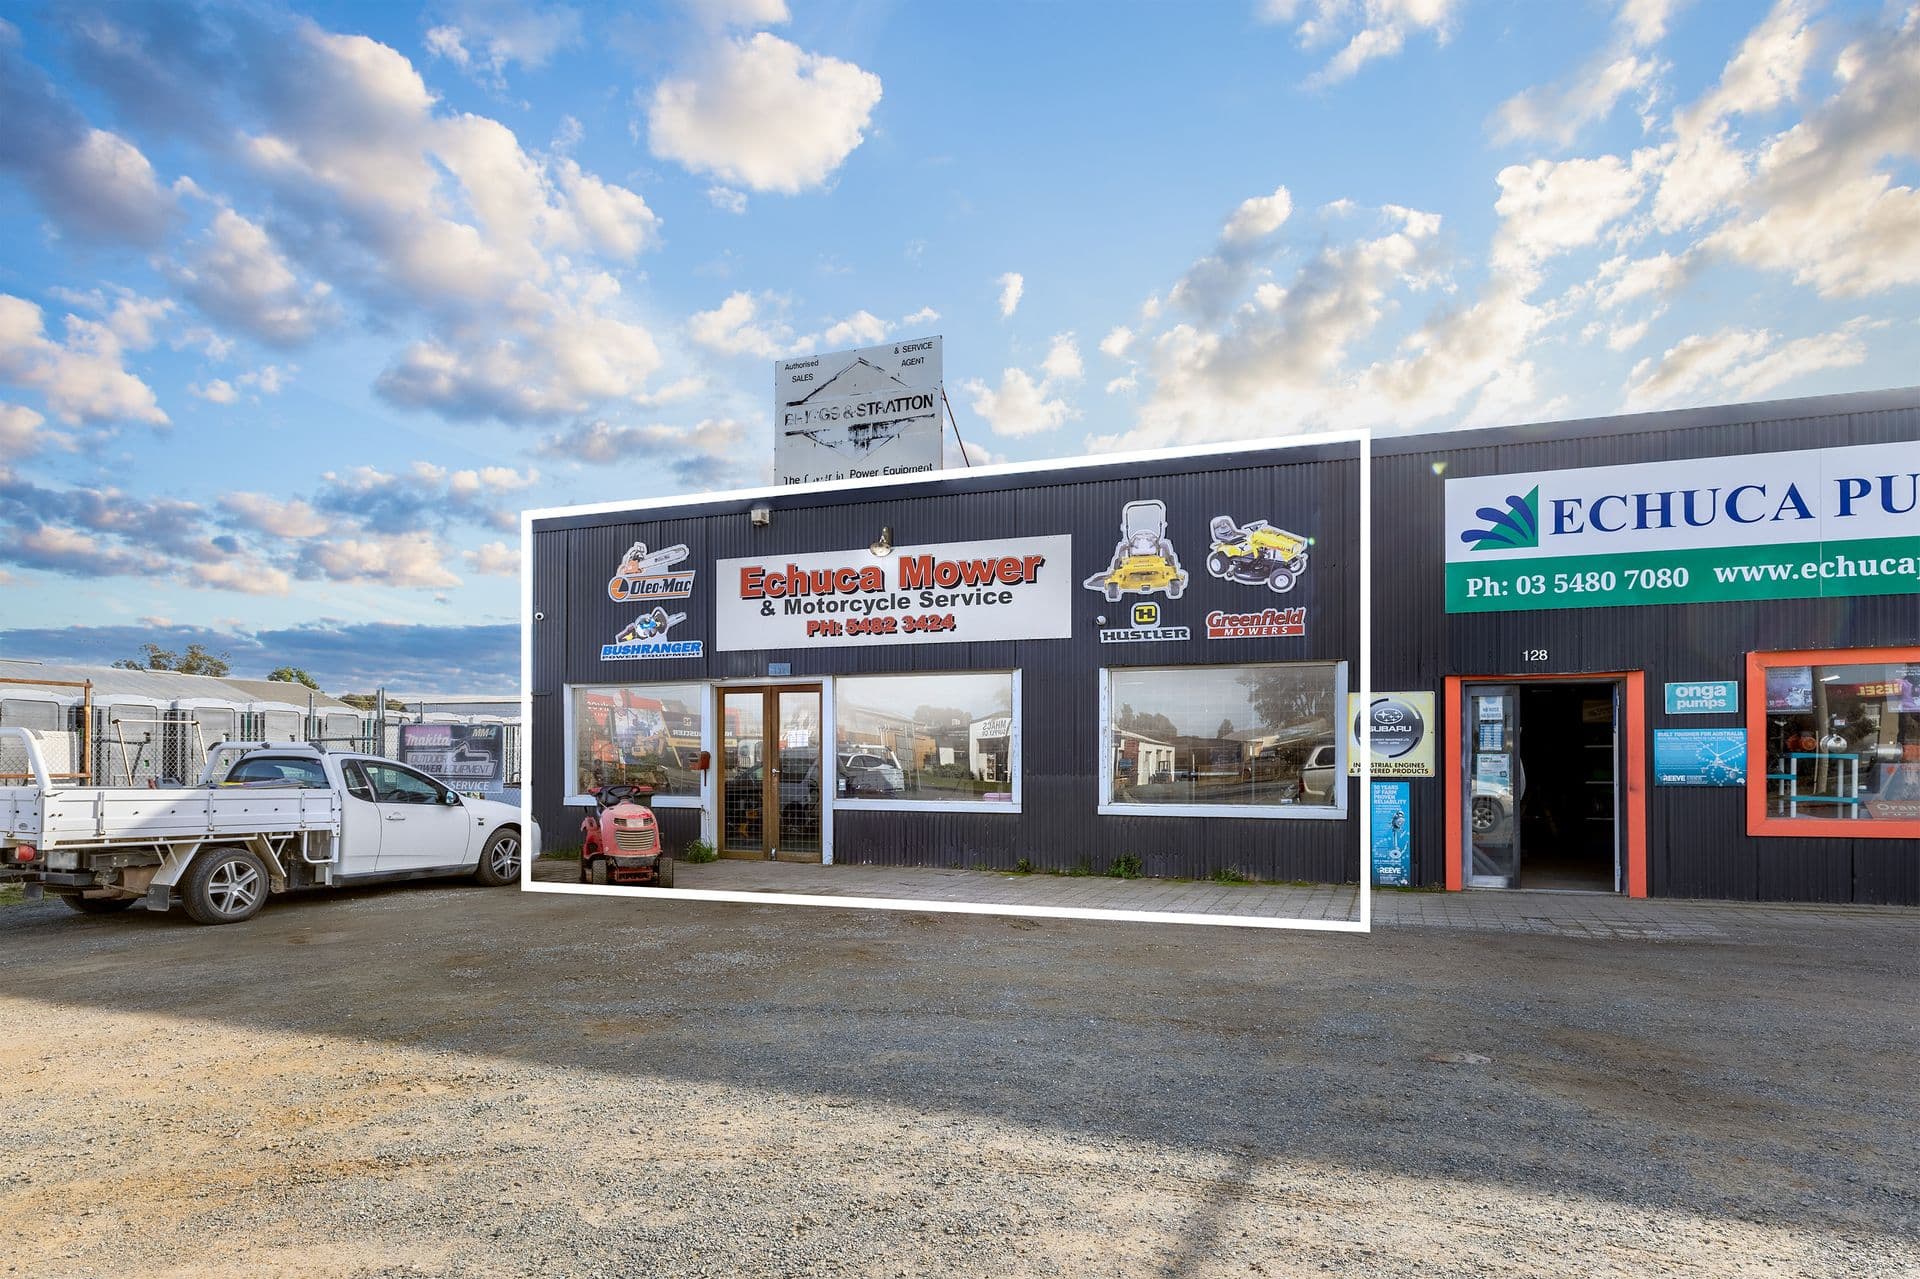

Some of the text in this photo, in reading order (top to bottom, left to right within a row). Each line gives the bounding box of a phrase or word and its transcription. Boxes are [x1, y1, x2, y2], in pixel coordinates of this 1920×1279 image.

[902, 342, 933, 353] SERVICE
[785, 360, 819, 370] Authorised
[901, 357, 924, 367] AGENT
[792, 373, 813, 383] SALES
[856, 393, 934, 418] STRATTON
[850, 469, 879, 479] Power
[883, 463, 933, 476] Equipment
[1548, 481, 1816, 536] ECHUCA
[740, 553, 1046, 600] Echuca Mower
[1466, 576, 1509, 598] Ph:
[1515, 574, 1546, 596] 03
[1553, 570, 1617, 593] 5480
[1623, 567, 1690, 590] 7080
[630, 578, 691, 595] Oleo-Mac
[760, 587, 1014, 617] & Motorcycle Service
[1207, 608, 1304, 627] Greenfield
[806, 614, 956, 637] PH: 5482 3424
[1224, 626, 1289, 636] MOWERS
[1102, 629, 1188, 641] HUSTLER
[602, 641, 701, 655] BUSHRANGER
[1522, 649, 1548, 662] 128
[1675, 684, 1727, 700] onga
[1677, 697, 1726, 711] pumps
[472, 728, 497, 738] MM4
[444, 764, 489, 774] EQUIPMENT
[450, 781, 489, 790] SERVICE
